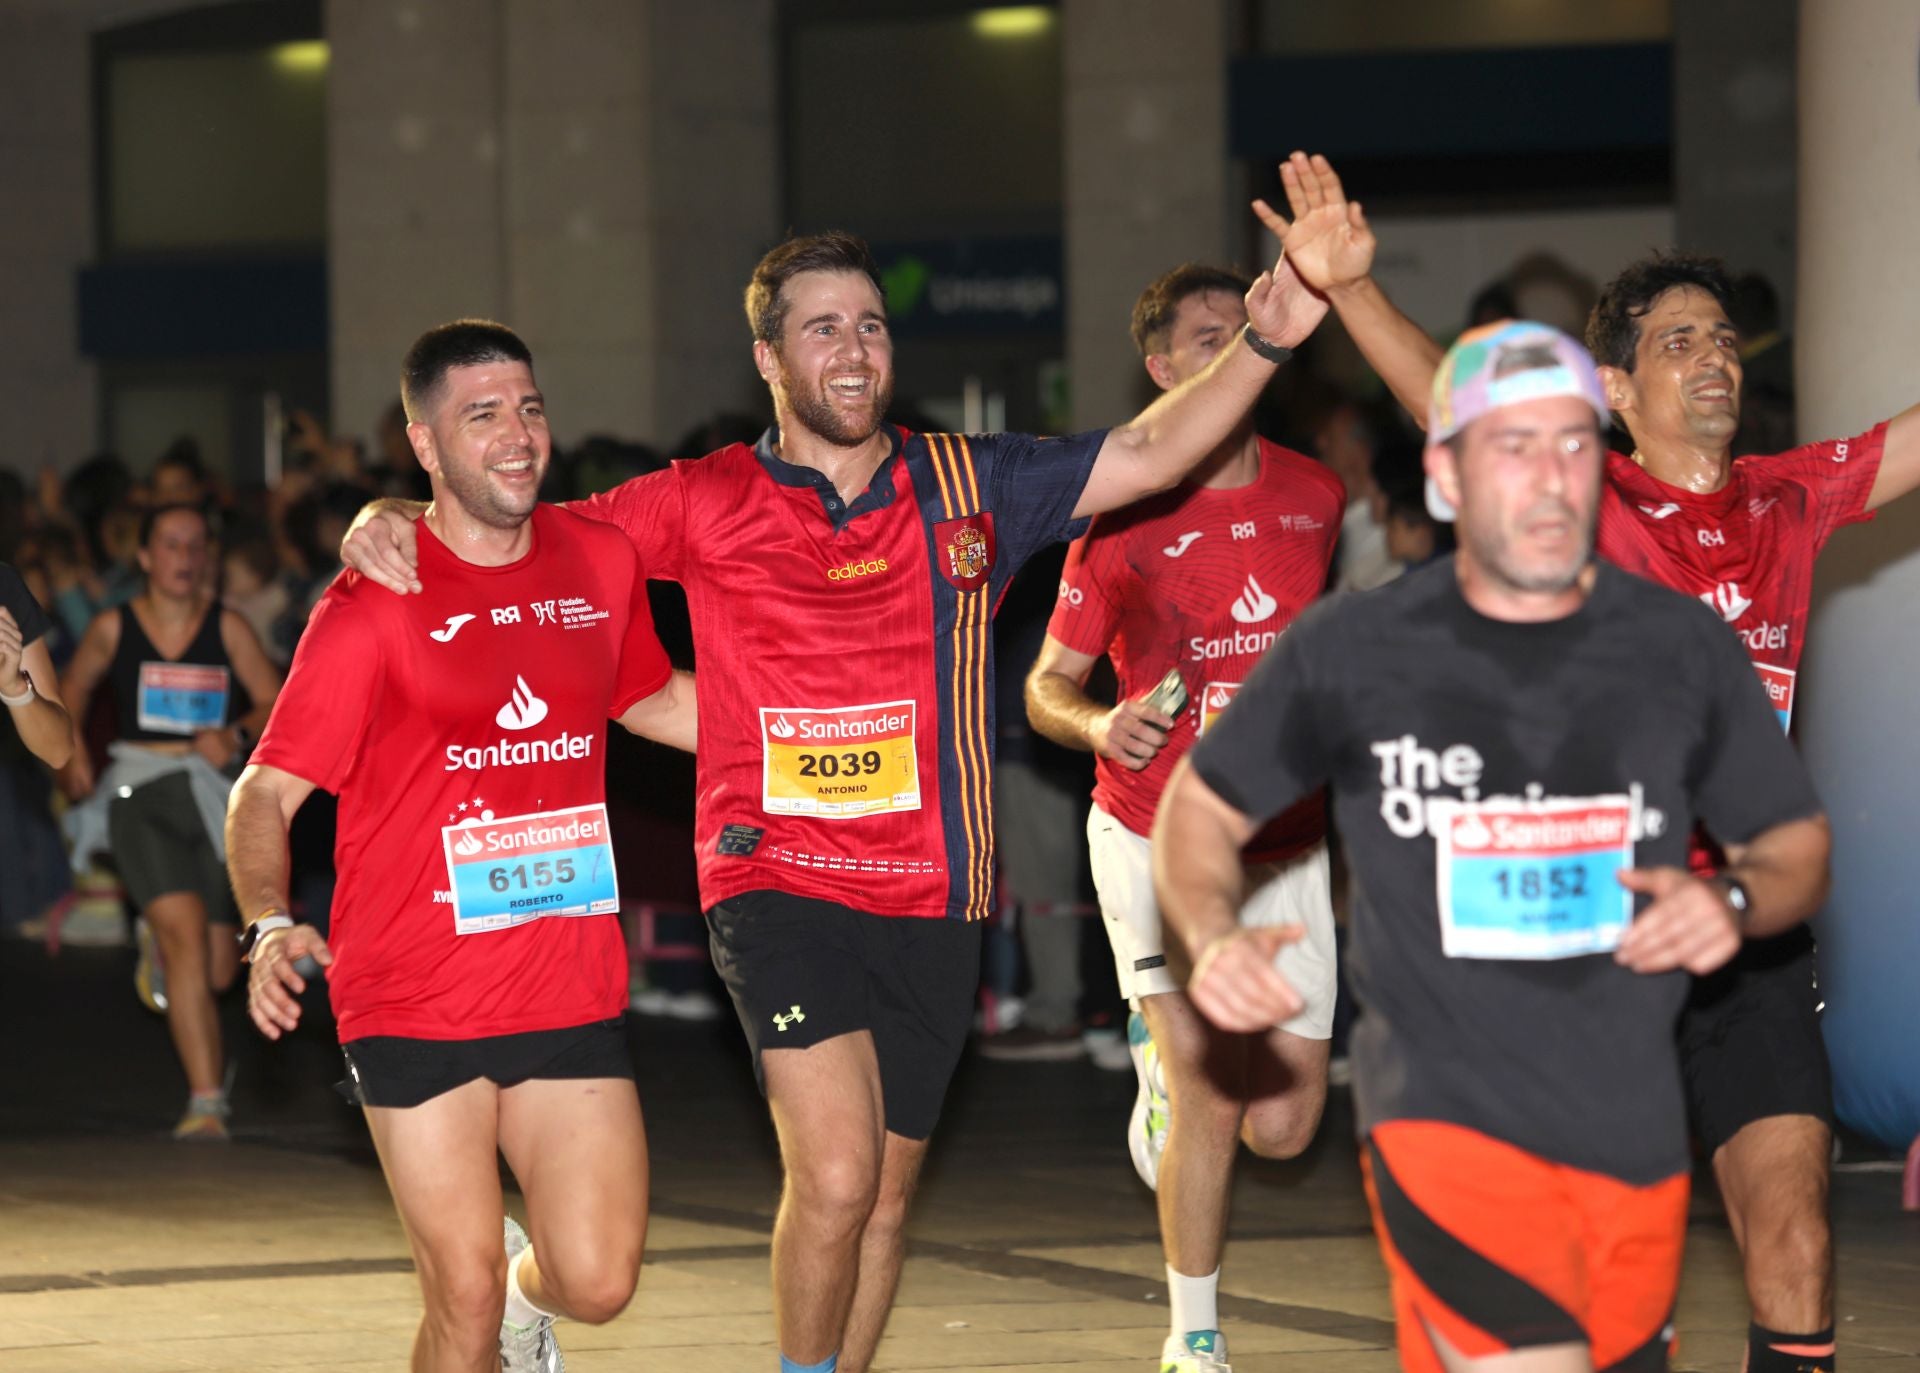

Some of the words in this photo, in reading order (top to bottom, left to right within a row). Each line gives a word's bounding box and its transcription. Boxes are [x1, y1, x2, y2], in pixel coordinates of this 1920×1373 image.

[828, 557, 888, 581] adidas
[558, 597, 586, 607] Ciudades
[560, 604, 593, 615] Patrimonio
[562, 615, 571, 624] de
[571, 614, 579, 622] la
[579, 611, 609, 621] Humanidad
[1190, 624, 1287, 661] Santan
[799, 713, 909, 740] Santander
[444, 732, 594, 771] Santander
[799, 750, 881, 778] 2039
[1370, 733, 1484, 790] The
[817, 784, 868, 795] ANTONIO
[485, 820, 601, 852] Santander
[1491, 814, 1624, 849] Santander
[488, 857, 576, 893] 6155
[1494, 864, 1588, 901] 1852
[510, 893, 564, 909] ROBERTO
